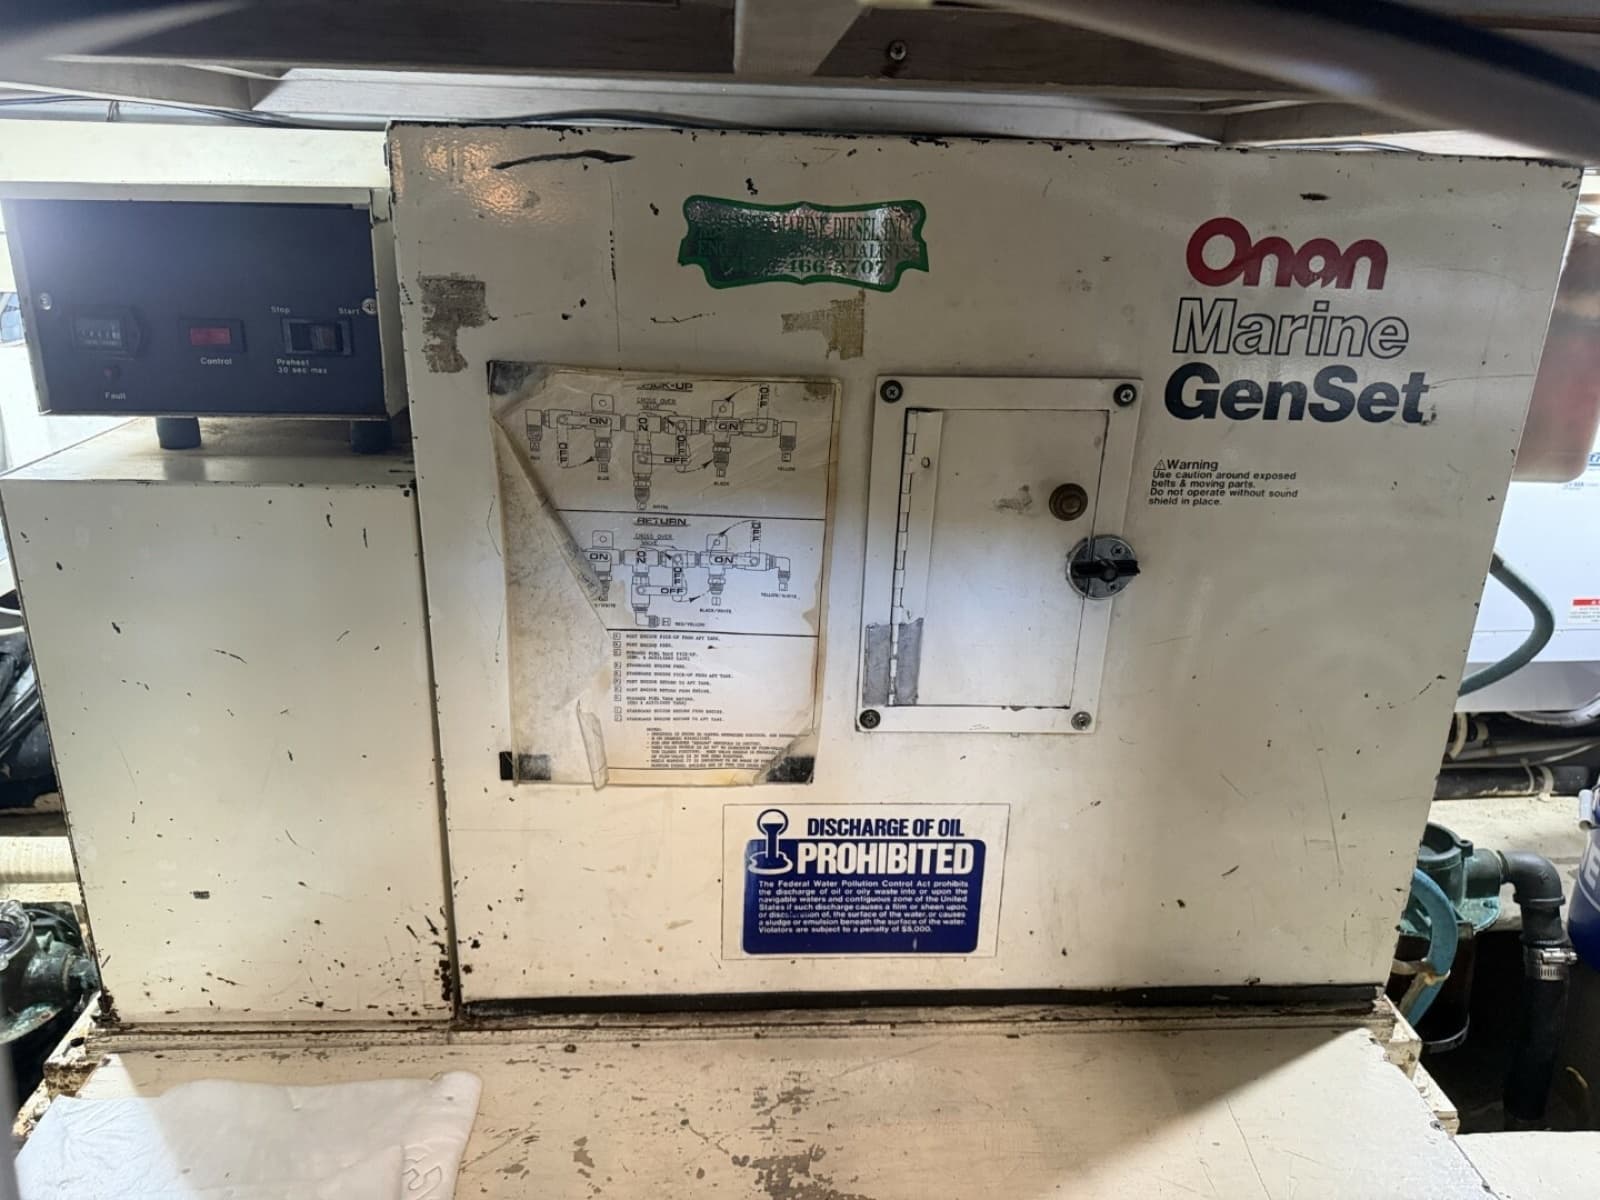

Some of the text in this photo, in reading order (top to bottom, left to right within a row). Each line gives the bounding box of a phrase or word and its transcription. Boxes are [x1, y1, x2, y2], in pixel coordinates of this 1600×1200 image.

[833, 215, 879, 241] DIESEL
[1186, 217, 1388, 290] Onan
[271, 306, 291, 314] Stop
[1172, 297, 1409, 359] Marine
[200, 357, 232, 366] Control
[104, 391, 127, 401] Fault
[1164, 361, 1430, 423] GenSet
[760, 387, 769, 408] OFF
[589, 417, 608, 425] ON
[639, 417, 649, 431] ON
[718, 422, 739, 430] ON
[558, 442, 568, 463] OFF
[664, 456, 689, 464] OFF
[1167, 459, 1219, 471] Warning
[1152, 470, 1297, 481] Use caution around exposed
[1151, 480, 1256, 489] belts & moving parts.
[1150, 488, 1299, 498] Do not operate without sound
[1148, 497, 1222, 507] shield in place.
[637, 517, 687, 526] RETURN
[589, 552, 609, 560] ON
[637, 550, 647, 564] ON
[714, 556, 734, 564] ON
[808, 818, 965, 837] DISCHARGE OF OIL
[797, 842, 974, 875] PROHIBITED
[778, 880, 810, 888] Federal
[813, 880, 838, 888] Water
[841, 880, 878, 888] Pollution
[881, 880, 913, 888] Control
[917, 880, 931, 888] Act
[933, 880, 969, 889] prohibits
[759, 888, 771, 896] the
[775, 888, 816, 897] discharge
[856, 888, 870, 897] oily
[931, 889, 952, 897] upon
[759, 896, 797, 904] navigable
[845, 896, 891, 904] contiguous
[815, 904, 854, 912] discharge
[765, 919, 791, 927] sludge
[811, 927, 841, 935] subject
[860, 927, 889, 935] penalty
[891, 926, 900, 934] of
